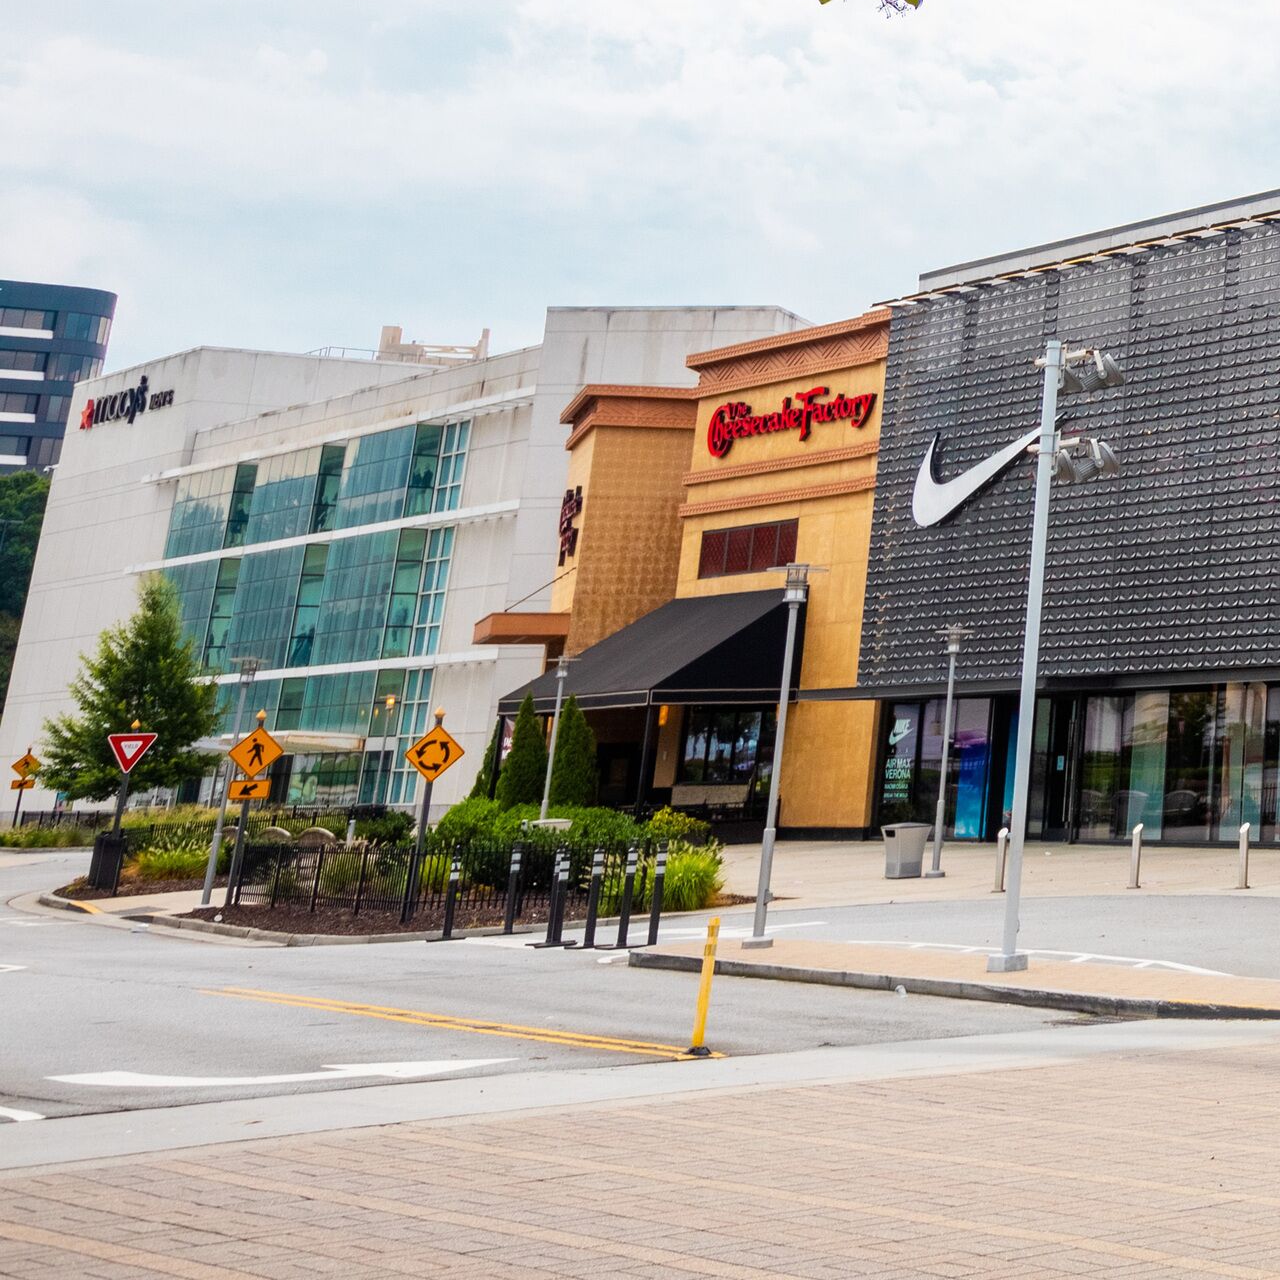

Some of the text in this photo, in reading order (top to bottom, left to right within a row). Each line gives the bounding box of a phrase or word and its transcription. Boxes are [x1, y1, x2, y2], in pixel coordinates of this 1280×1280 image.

[727, 402, 751, 418] The
[707, 386, 877, 458] Cheesecake Factory
[897, 758, 911, 768] MAX
[885, 768, 911, 779] VERONA
